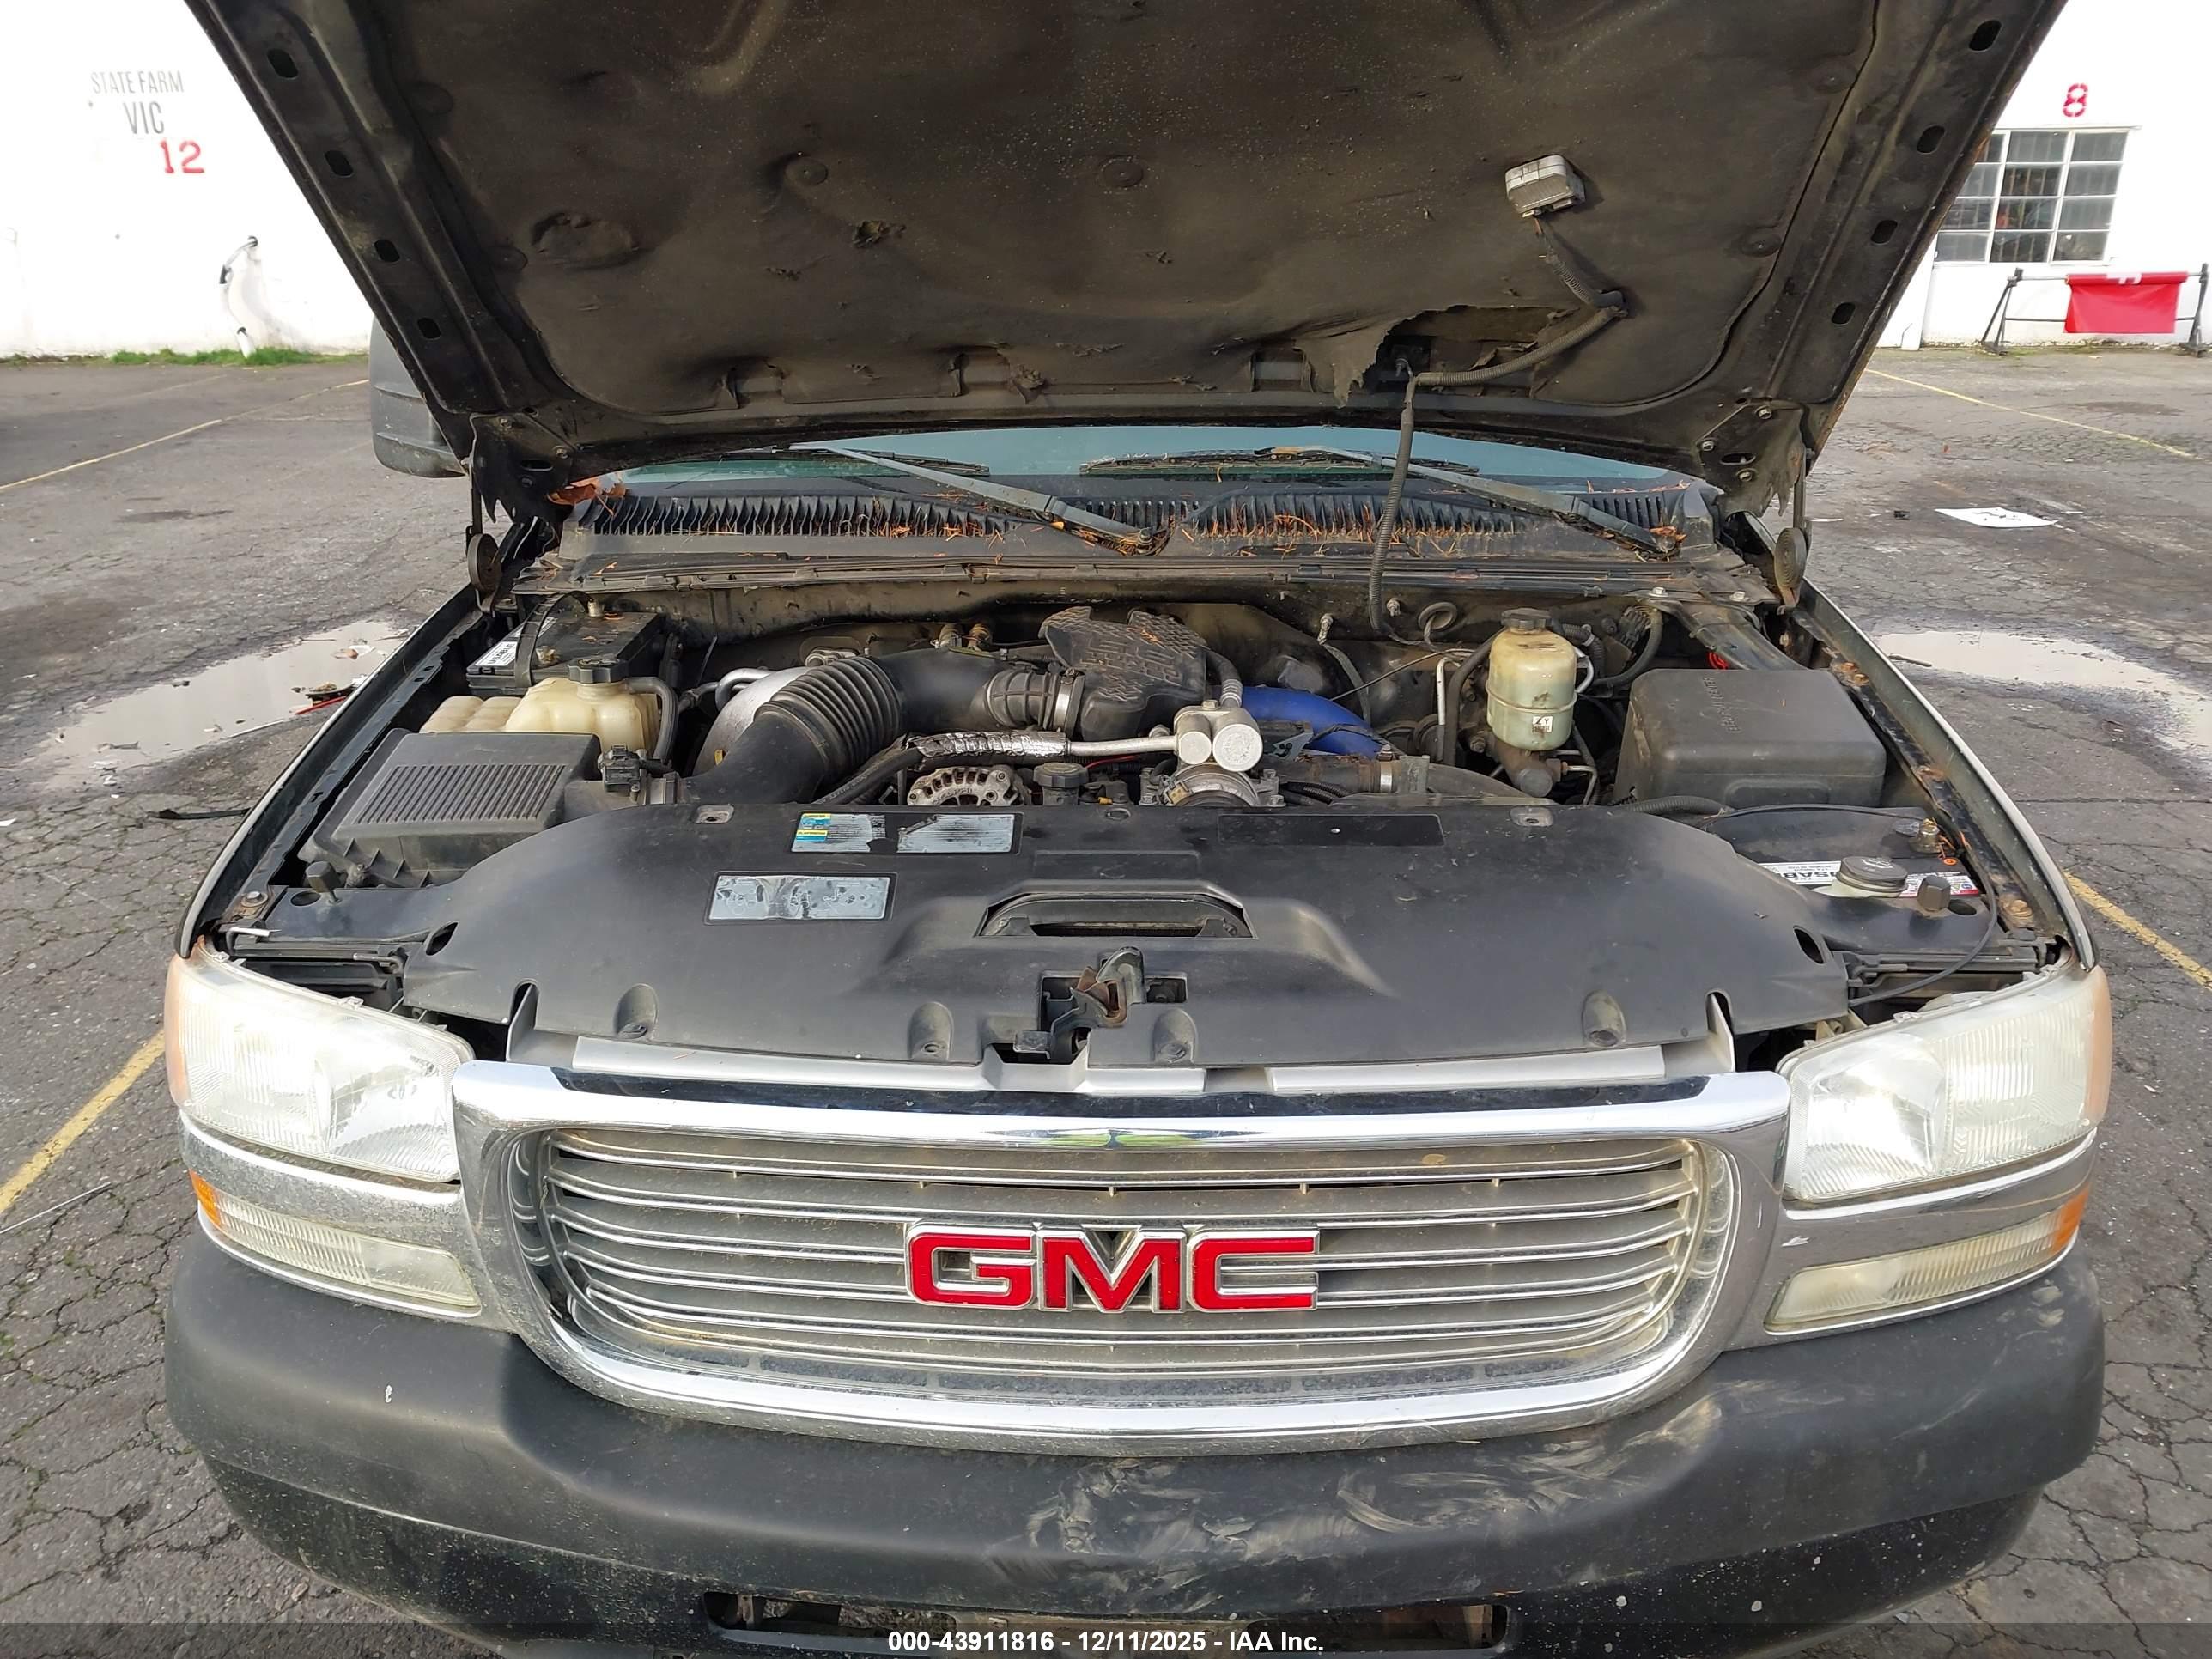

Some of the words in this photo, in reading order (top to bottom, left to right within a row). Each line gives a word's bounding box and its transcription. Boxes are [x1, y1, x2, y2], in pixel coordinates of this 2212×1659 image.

[90, 71, 136, 94] STATE
[137, 70, 185, 94] FARM
[123, 100, 165, 135] VIC
[2063, 83, 2088, 118] 8
[160, 139, 205, 174] 12
[906, 1223, 1321, 1314] GMC
